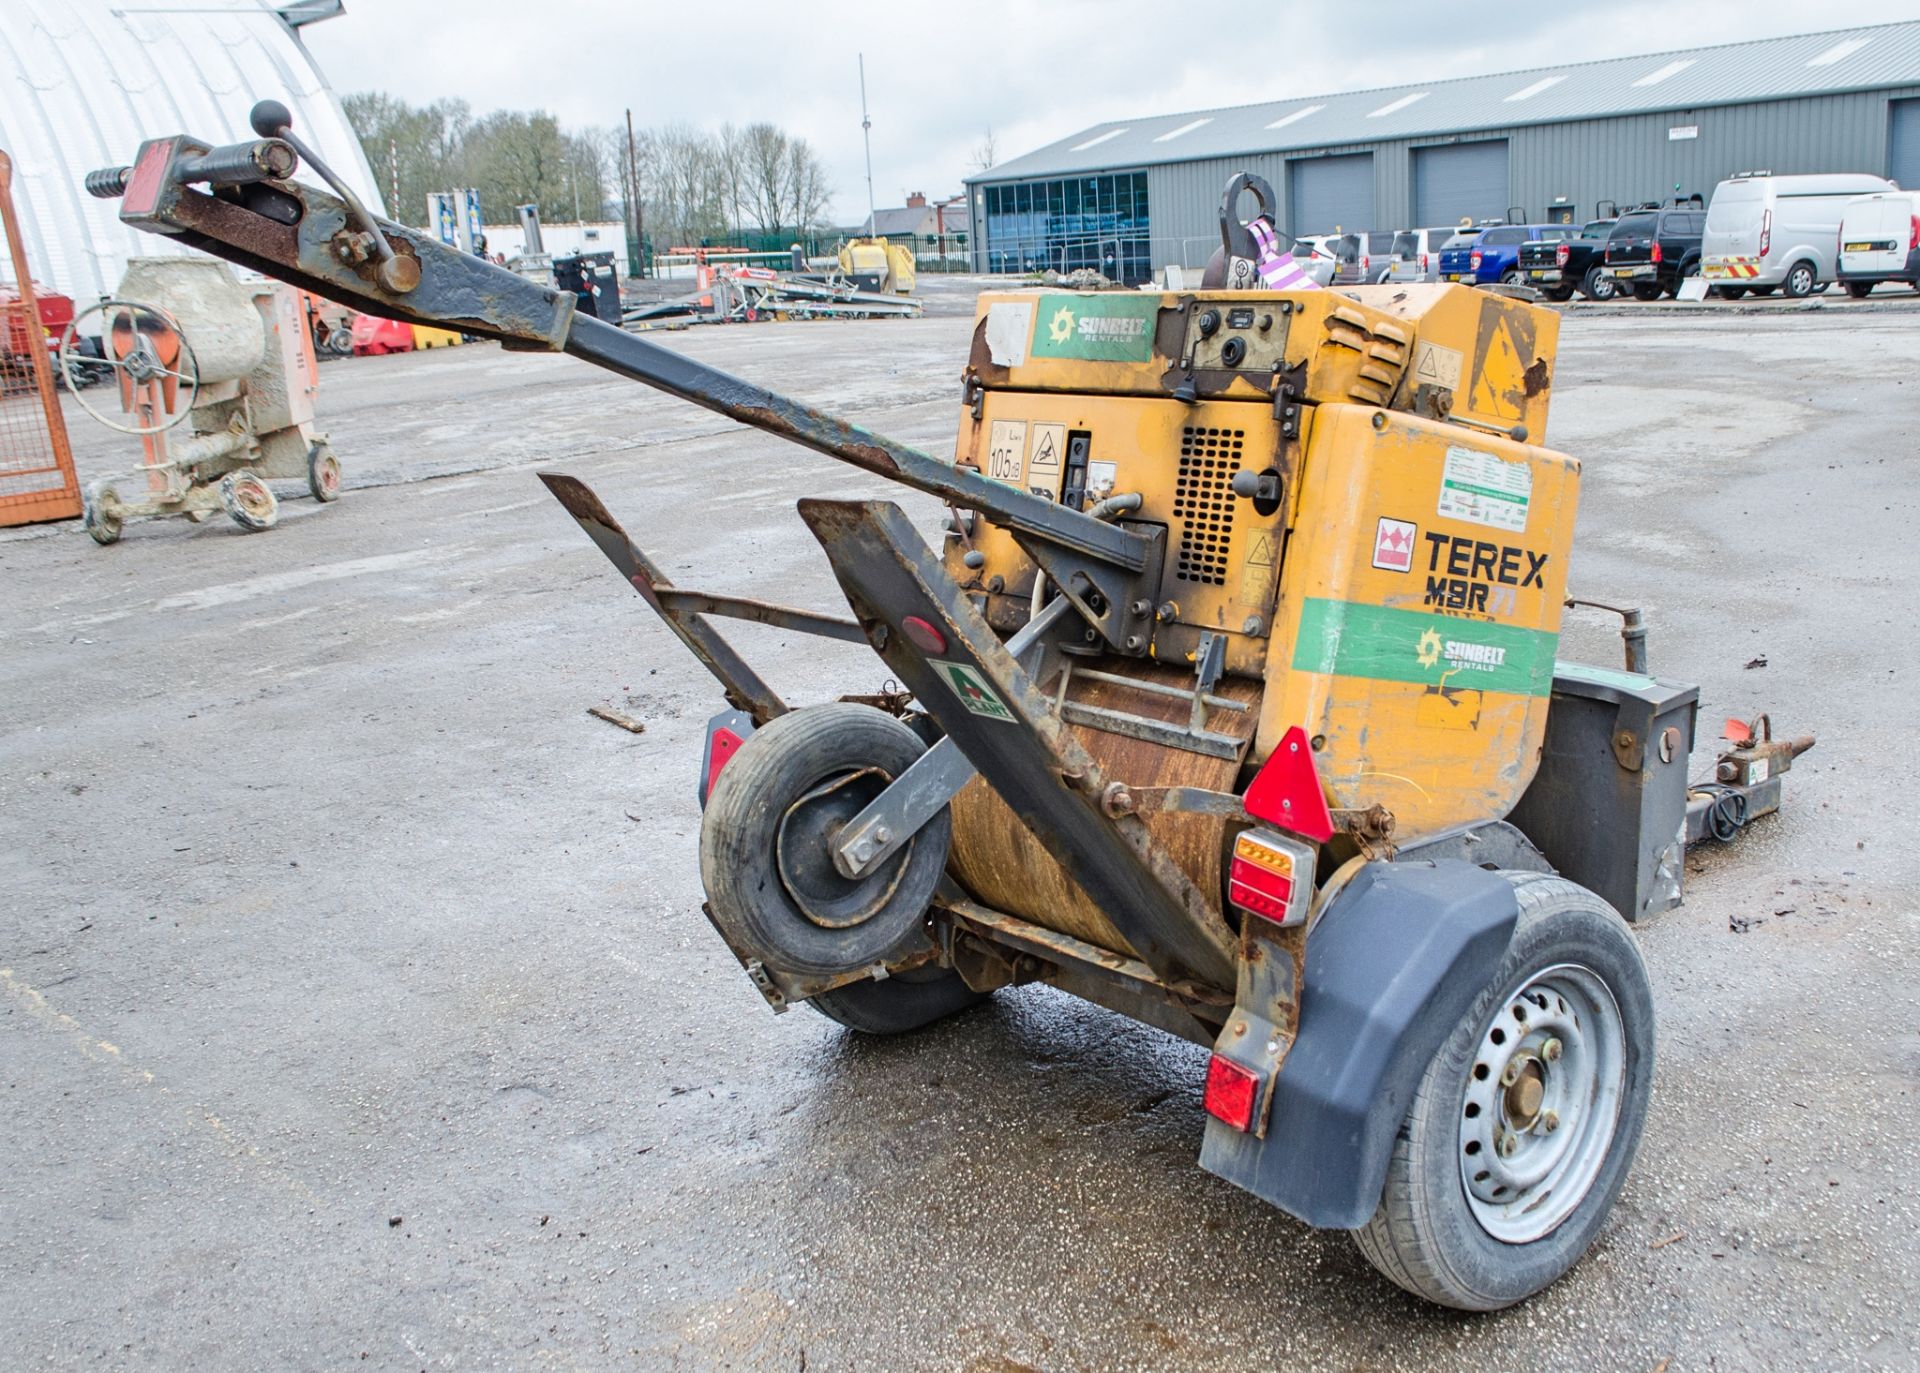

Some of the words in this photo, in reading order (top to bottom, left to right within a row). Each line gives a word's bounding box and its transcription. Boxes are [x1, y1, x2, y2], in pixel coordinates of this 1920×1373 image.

[1078, 317, 1146, 335] SUNBELT
[1085, 334, 1133, 343] RENTALS
[991, 448, 1012, 478] 105
[1425, 531, 1548, 589] TEREX
[1444, 640, 1506, 665] SUNBELT
[1451, 660, 1495, 672] RENTALS
[963, 697, 1010, 718] PLANT
